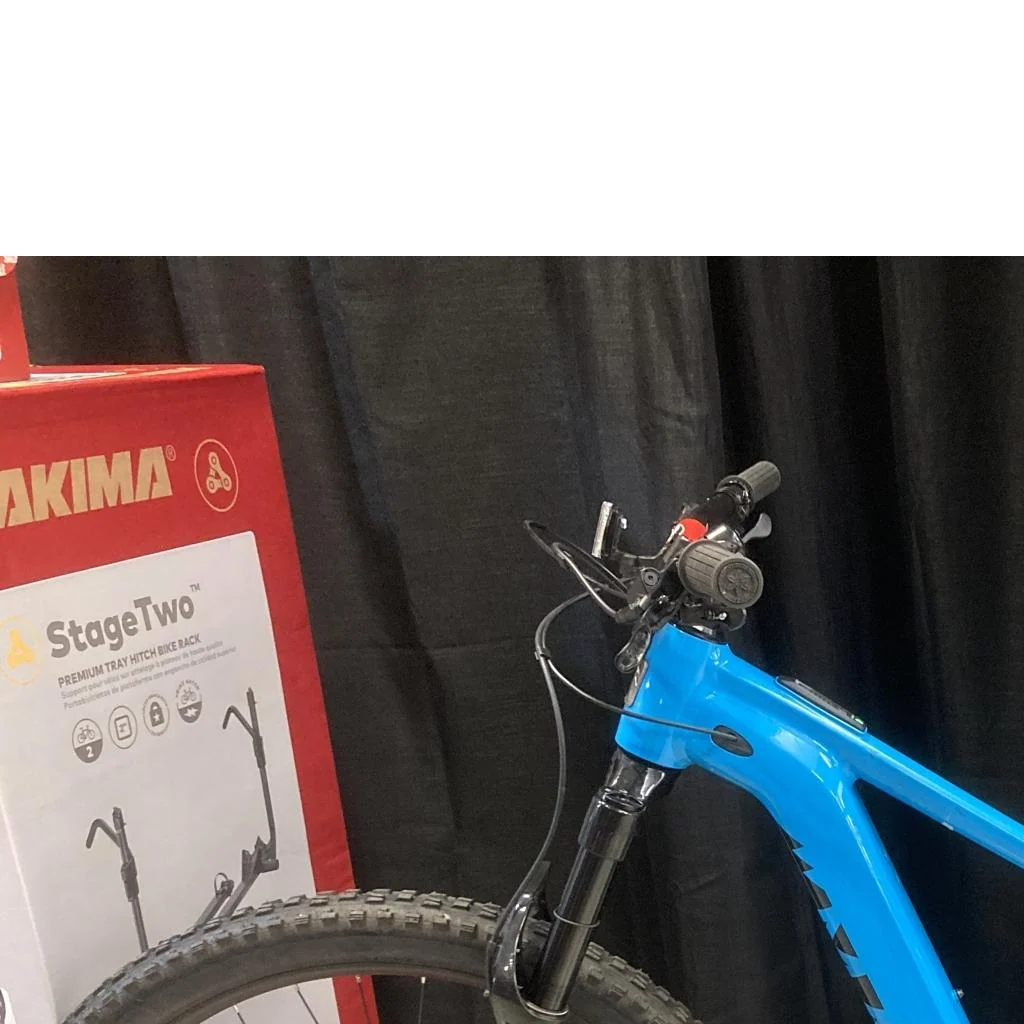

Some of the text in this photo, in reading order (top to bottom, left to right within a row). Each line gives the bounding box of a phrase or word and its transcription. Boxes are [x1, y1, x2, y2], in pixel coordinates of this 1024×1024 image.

[46, 595, 195, 658] StageTwo
[57, 665, 104, 688] PREMIUM
[104, 656, 129, 673] TRAY
[130, 647, 157, 667] HITCH
[157, 641, 177, 660] BIKE
[178, 633, 201, 649] RACK
[86, 745, 94, 758] 2
